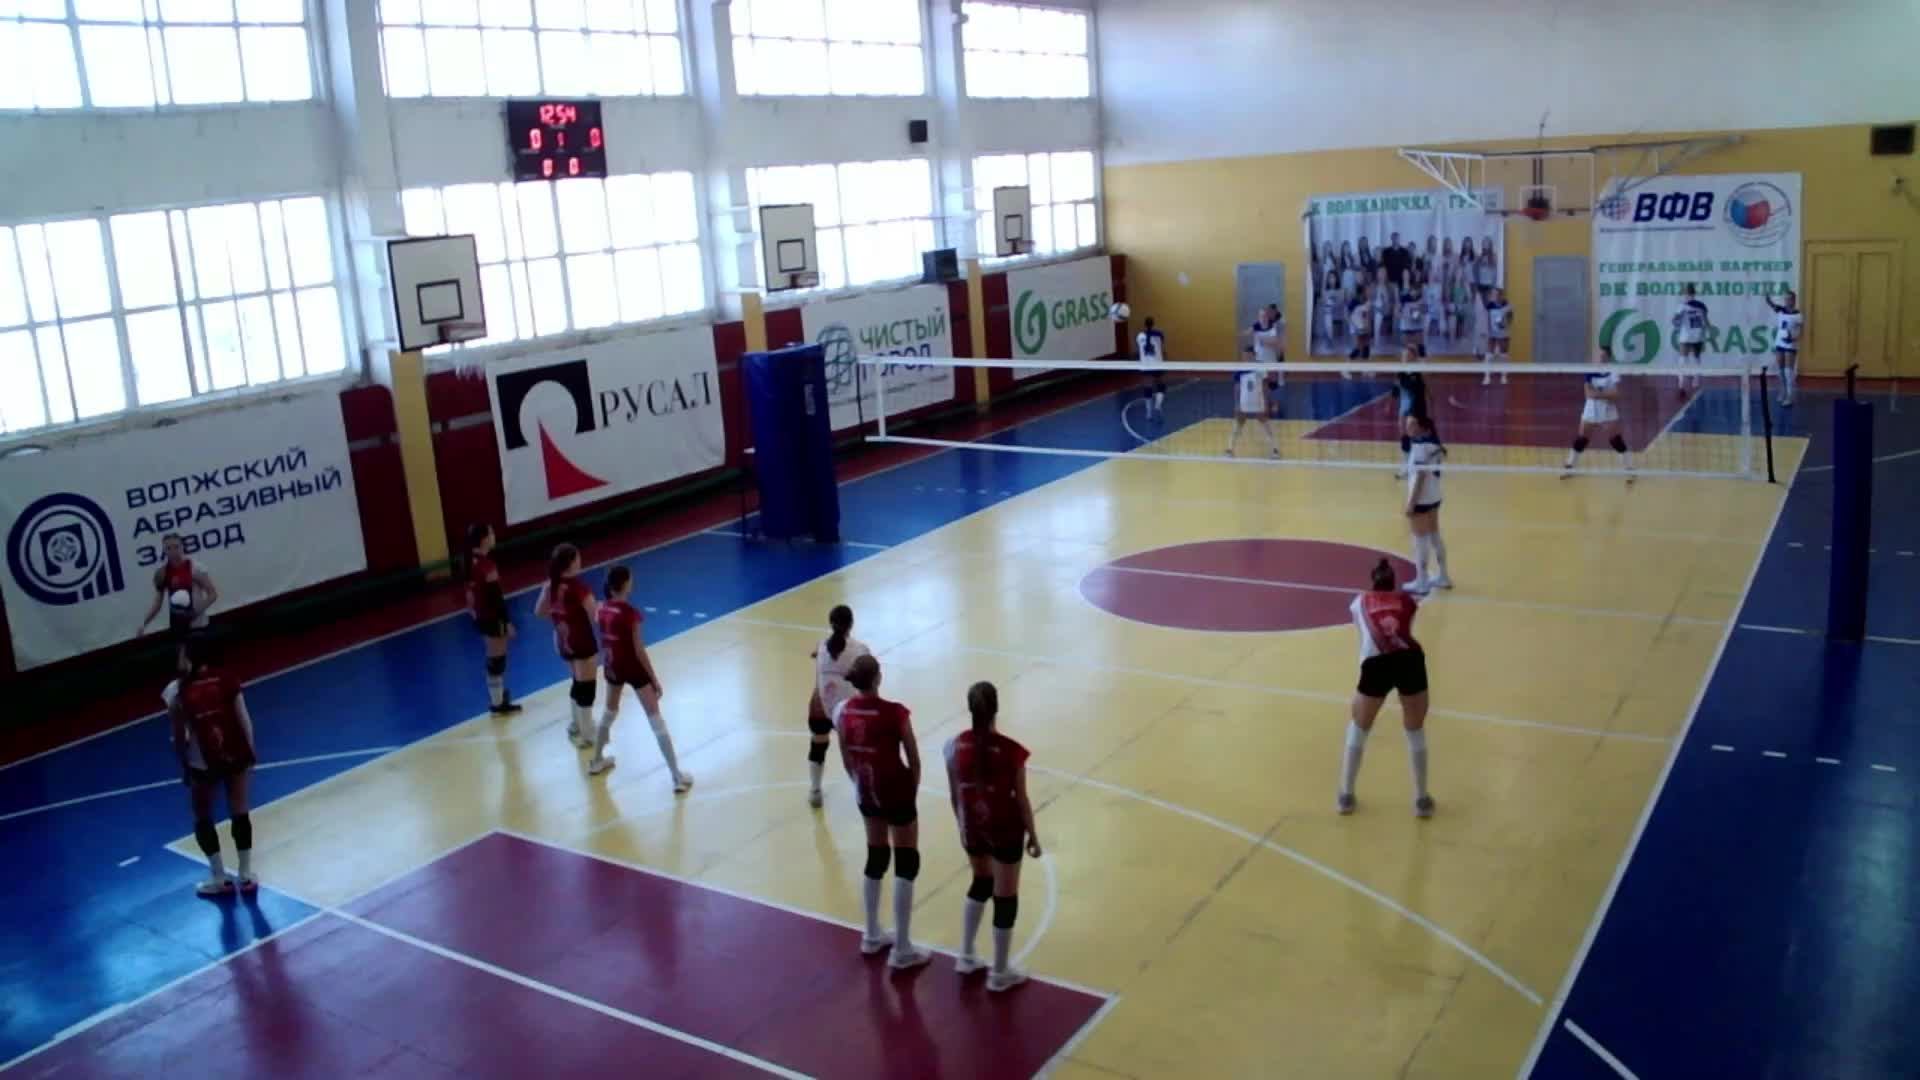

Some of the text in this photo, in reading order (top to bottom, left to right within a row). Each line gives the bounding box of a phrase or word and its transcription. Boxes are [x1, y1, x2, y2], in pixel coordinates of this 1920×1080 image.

[529, 128, 542, 149] 0
[1633, 191, 1714, 222] ВФВ
[859, 306, 946, 351] ЧИСТЫЙ
[1052, 291, 1109, 330] GRASS
[1671, 323, 1779, 354] RAS
[599, 371, 713, 430] РУСАЛ
[125, 446, 308, 510] ВОЛЖСКИЙ
[132, 465, 343, 540] АБРАЗИВНЫЙ
[135, 522, 246, 567] ЗВОД
